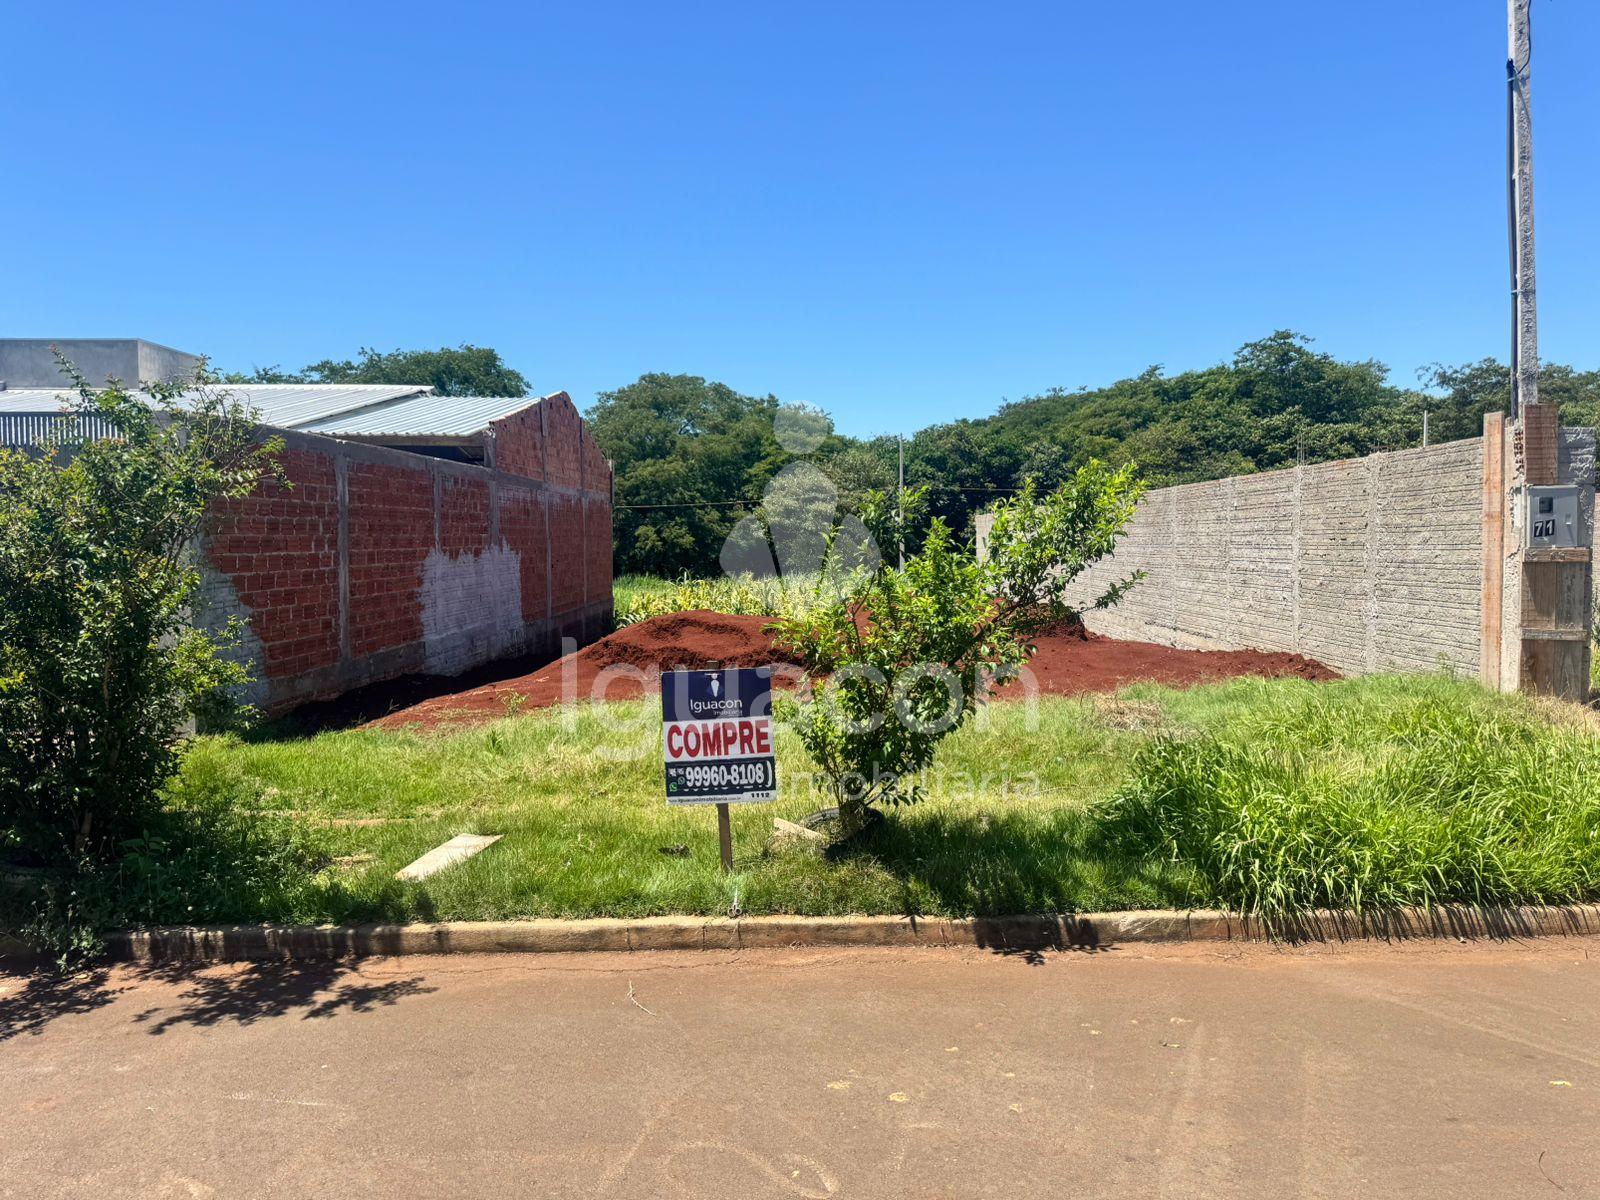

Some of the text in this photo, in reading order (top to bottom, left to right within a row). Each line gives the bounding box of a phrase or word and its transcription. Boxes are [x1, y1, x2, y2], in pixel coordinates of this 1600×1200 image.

[1534, 519, 1554, 537] 71
[690, 699, 743, 714] Iguacon
[667, 720, 771, 758] COMPRE
[685, 762, 765, 787] 99960-8108
